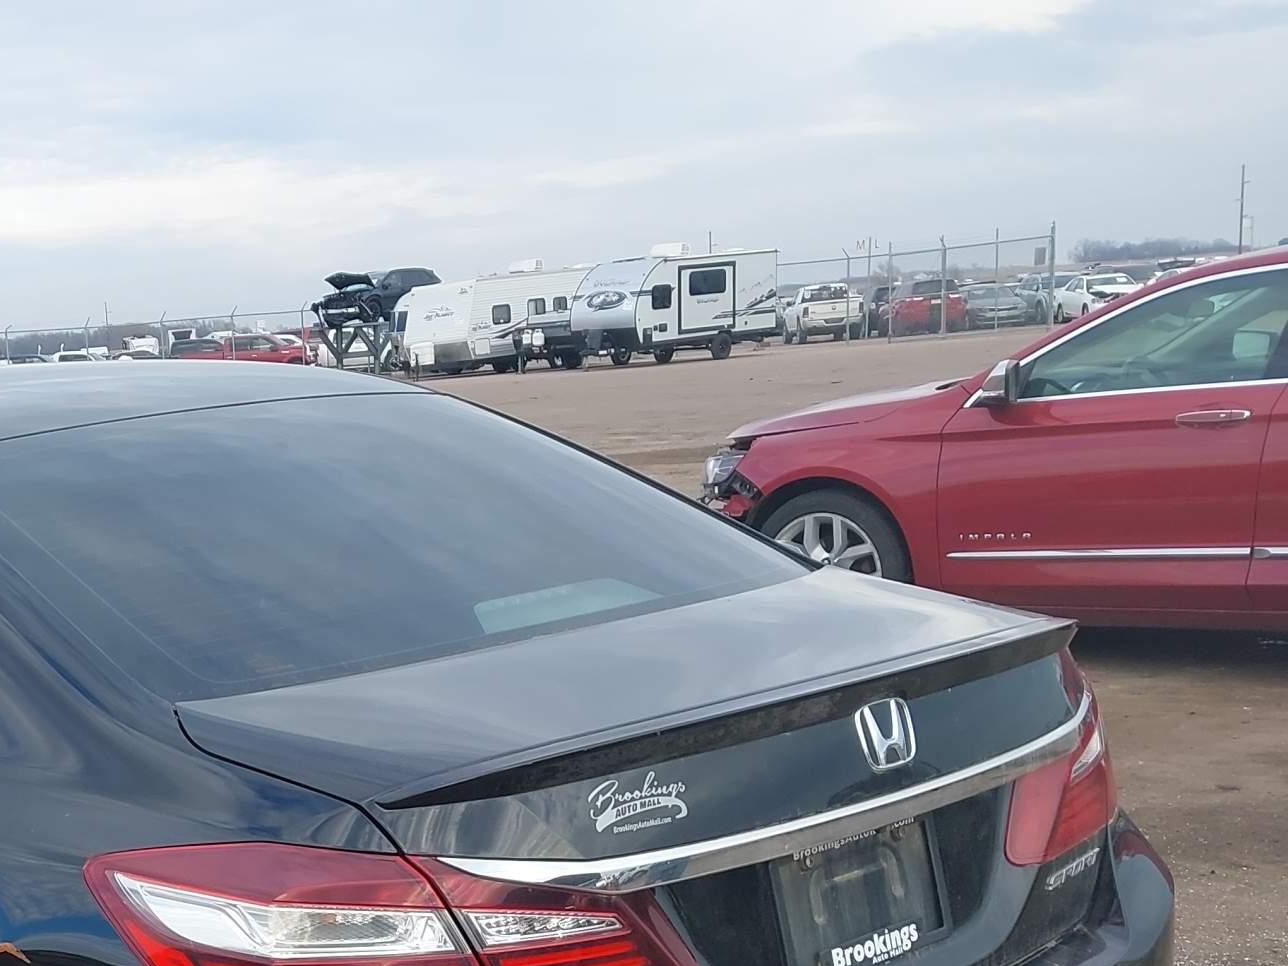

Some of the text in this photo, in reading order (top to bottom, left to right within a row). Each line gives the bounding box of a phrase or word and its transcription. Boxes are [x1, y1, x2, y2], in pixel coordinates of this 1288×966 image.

[588, 771, 687, 819] Brookings
[615, 798, 662, 819] AUTO MALL
[872, 947, 904, 965] Auto Mall
